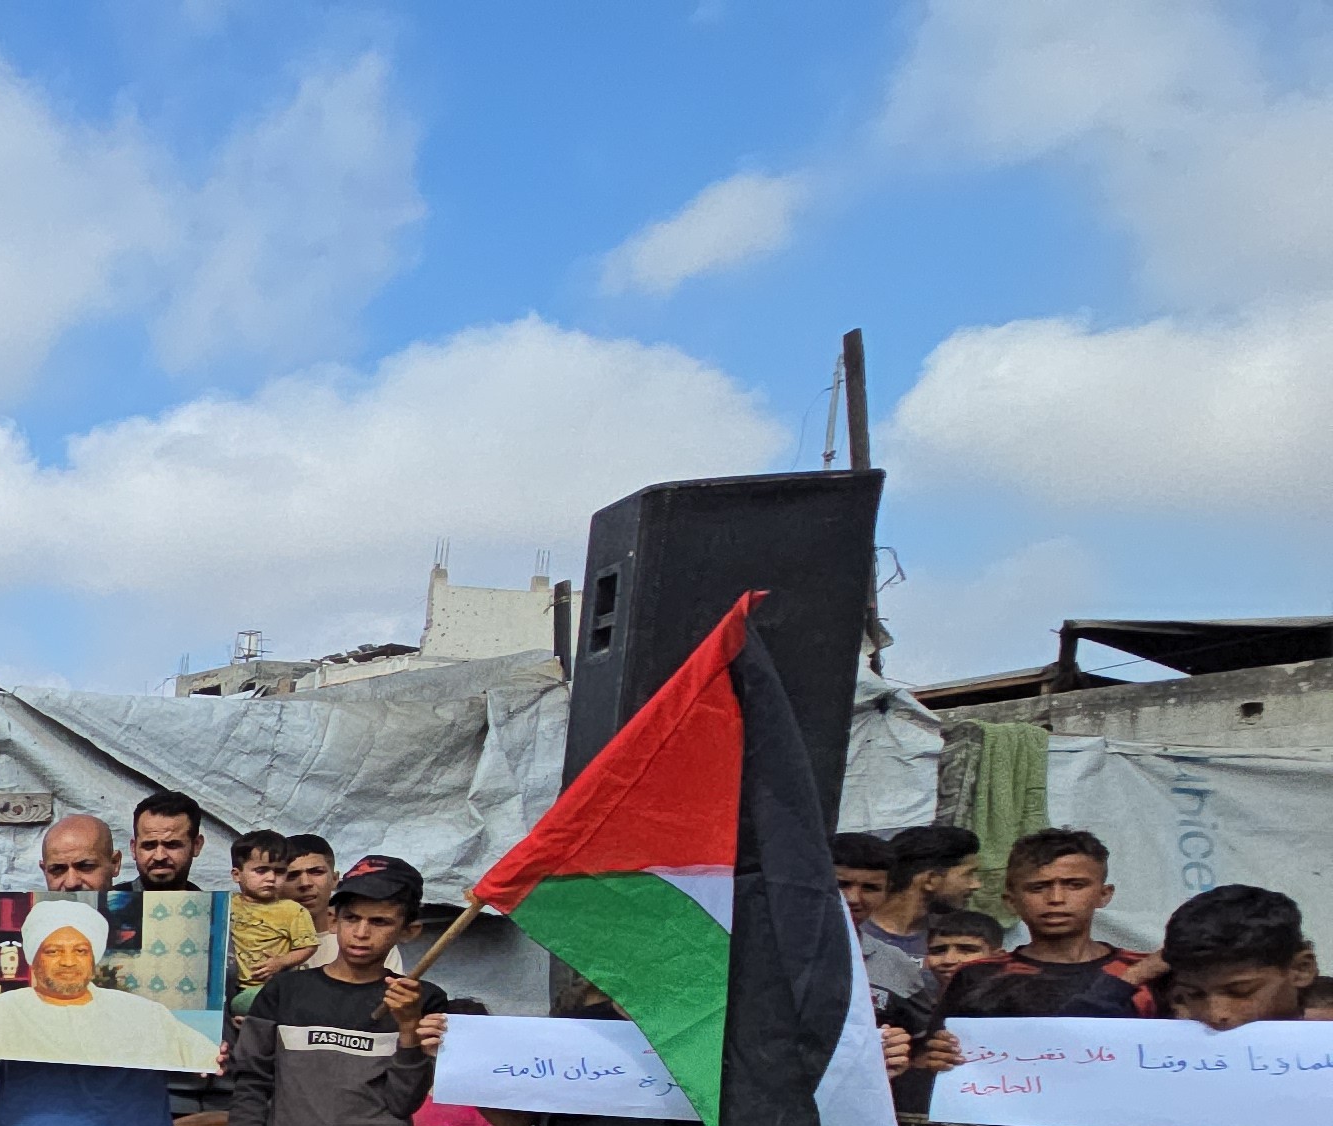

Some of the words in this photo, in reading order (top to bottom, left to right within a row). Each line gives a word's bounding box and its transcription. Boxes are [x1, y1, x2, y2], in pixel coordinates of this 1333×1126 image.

[311, 1031, 371, 1050] FASHION
[563, 1056, 627, 1081] عنوان
[1247, 1045, 1333, 1076] لماؤنا
